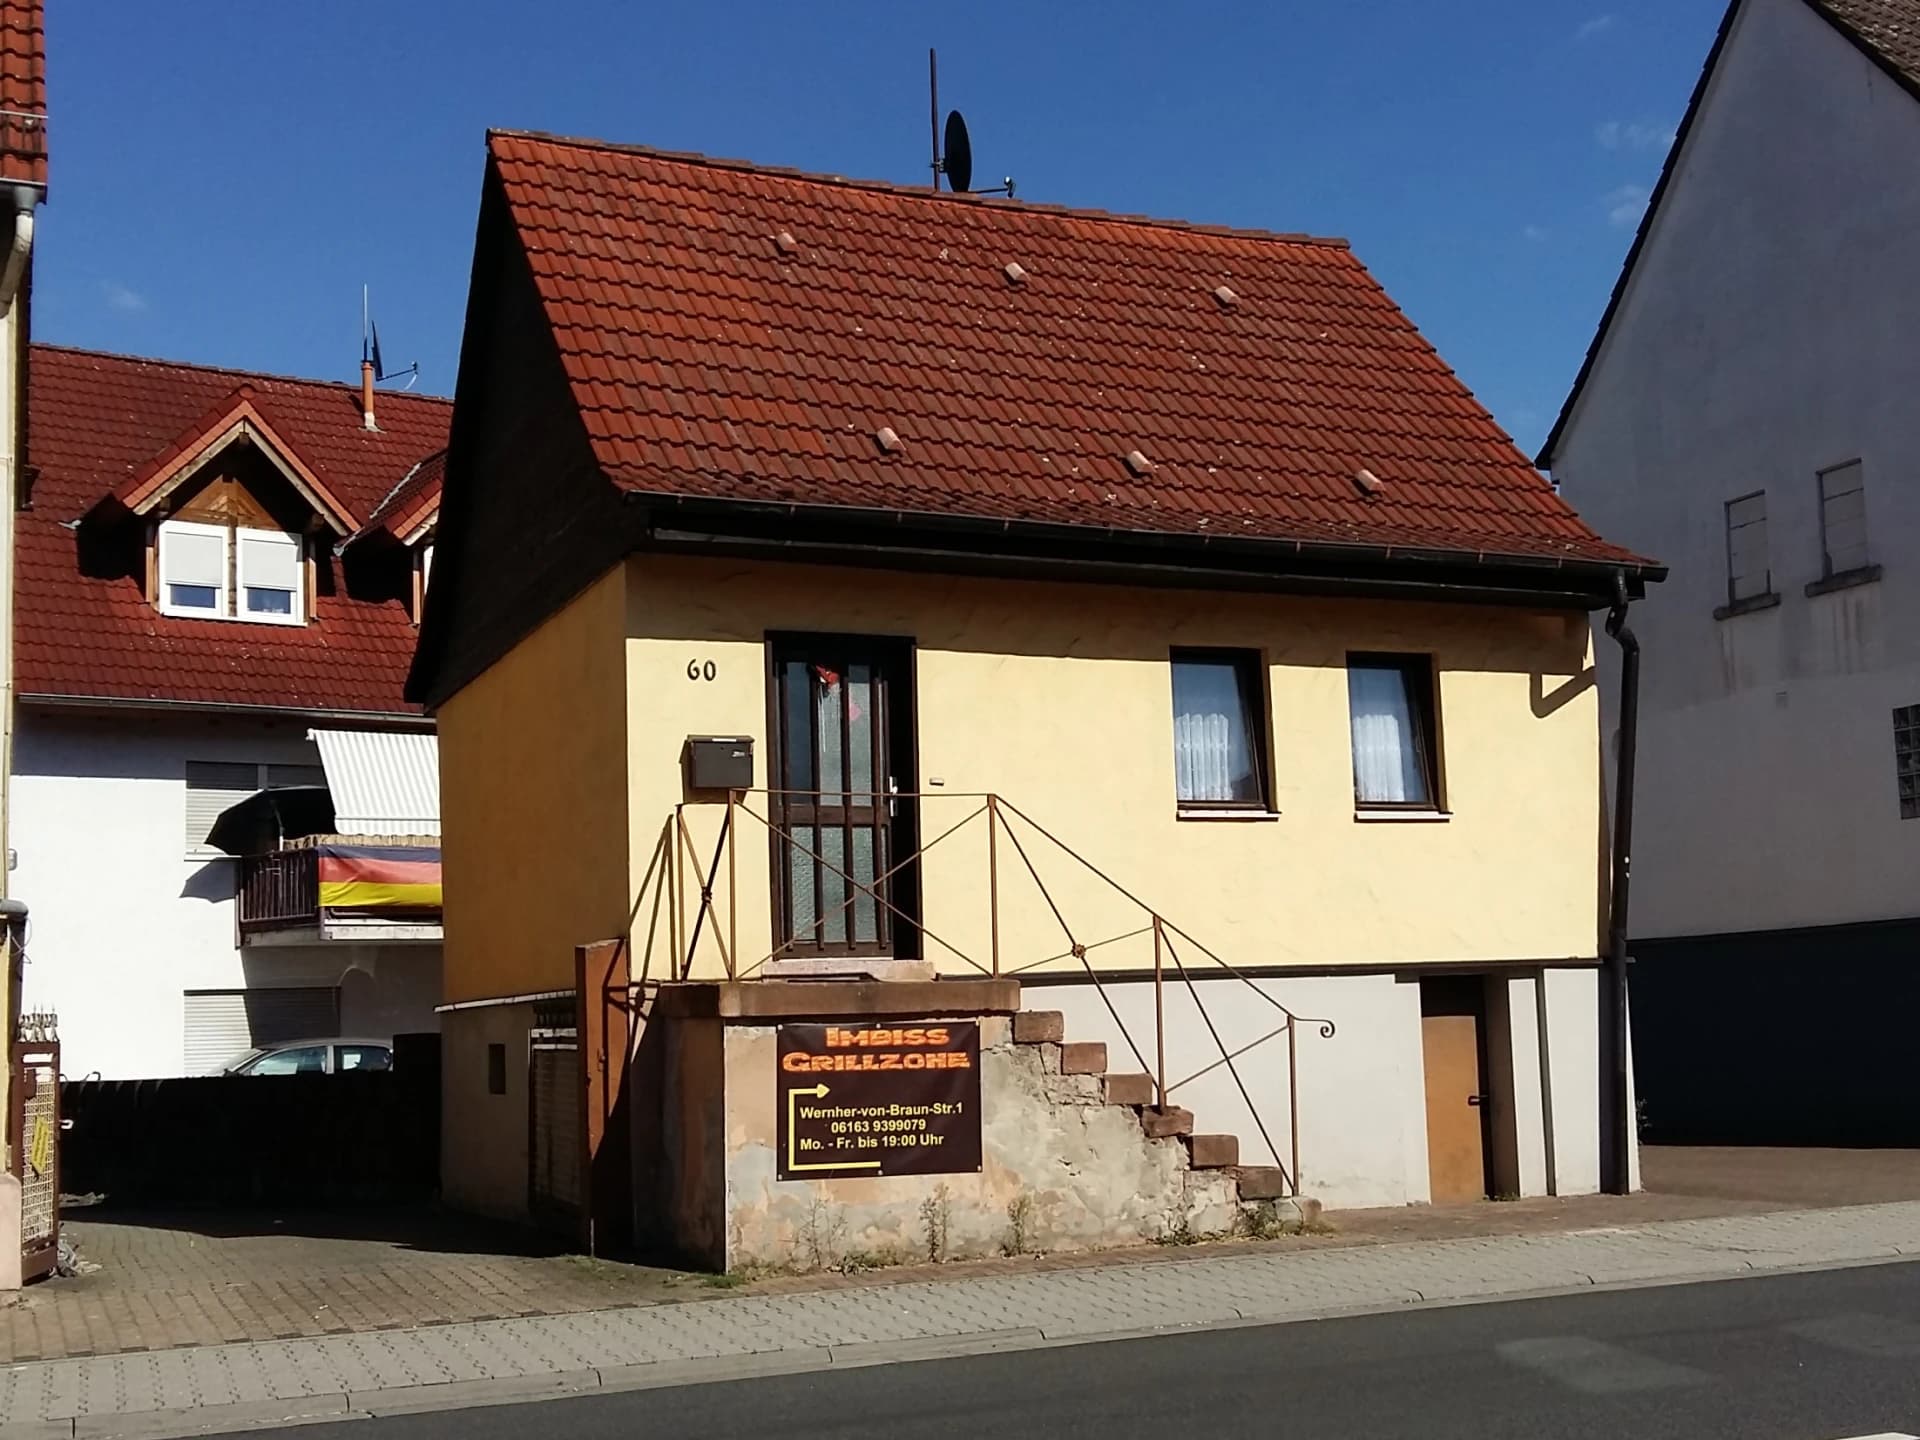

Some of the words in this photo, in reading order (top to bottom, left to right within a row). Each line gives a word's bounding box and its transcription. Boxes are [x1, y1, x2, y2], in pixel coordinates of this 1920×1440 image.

[687, 658, 716, 681] 60
[800, 1102, 962, 1118] Wernher-von-Braun-Str.1
[831, 1121, 869, 1133] 06163
[873, 1120, 926, 1131] 9399079
[800, 1139, 824, 1150] Mo.
[836, 1138, 854, 1148] Fr.
[858, 1136, 878, 1148] bis
[882, 1135, 916, 1147] 19:00
[920, 1134, 944, 1145] Uhr
